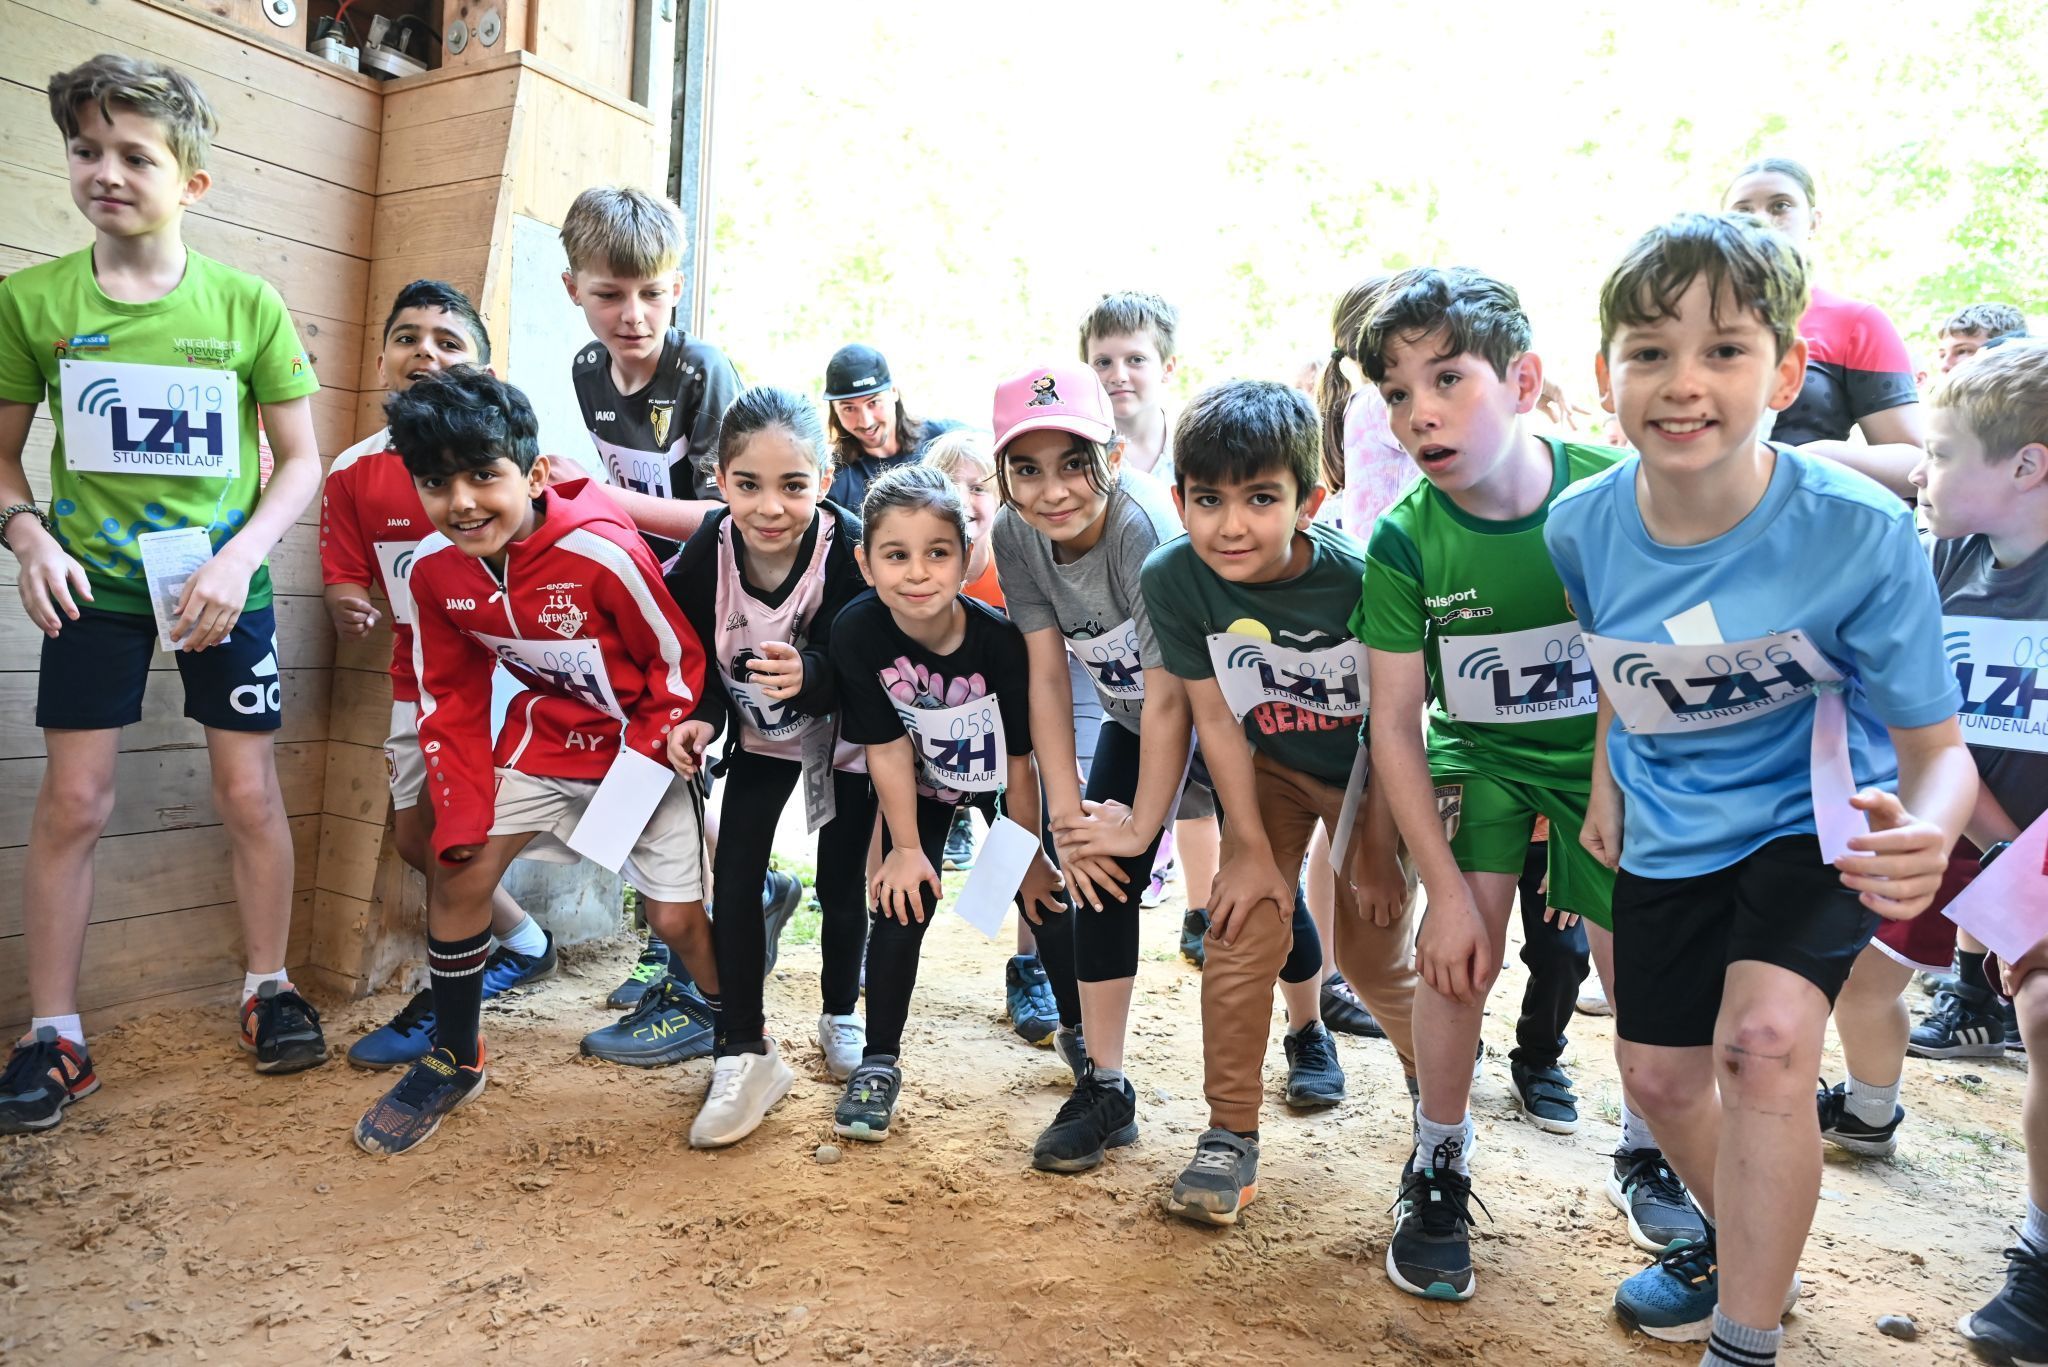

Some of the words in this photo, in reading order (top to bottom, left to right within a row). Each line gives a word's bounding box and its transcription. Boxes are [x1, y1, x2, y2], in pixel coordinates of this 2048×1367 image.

[173, 336, 241, 352] vorarlberg
[167, 383, 222, 413] 019
[110, 406, 223, 456] LZH
[113, 451, 223, 468] STUNDENLAUF
[633, 460, 662, 485] 008
[387, 518, 410, 527] JAKO
[445, 598, 476, 610] JAKO
[538, 611, 588, 623] ALTENSTADT
[1092, 630, 1139, 661] 056
[1545, 634, 1585, 663] 06
[2013, 636, 2048, 668] 08
[544, 651, 592, 674] 086
[1085, 651, 1143, 686] ZH
[1299, 655, 1356, 678] 049
[1705, 643, 1793, 675] 066
[1258, 661, 1360, 704] LZH
[1650, 660, 1816, 714] LZH
[1263, 688, 1360, 711] STUNDENLAUF
[1495, 694, 1599, 715] STUNDENLAU
[1676, 683, 1813, 723] STUNDENLAU
[760, 712, 812, 737] STUNDEN
[950, 708, 994, 740] 058
[565, 730, 604, 751] AY
[911, 732, 997, 773] LZH
[926, 760, 996, 782] UNDENLAUF
[1435, 787, 1457, 799] STRIA
[633, 1014, 690, 1042] CMP
